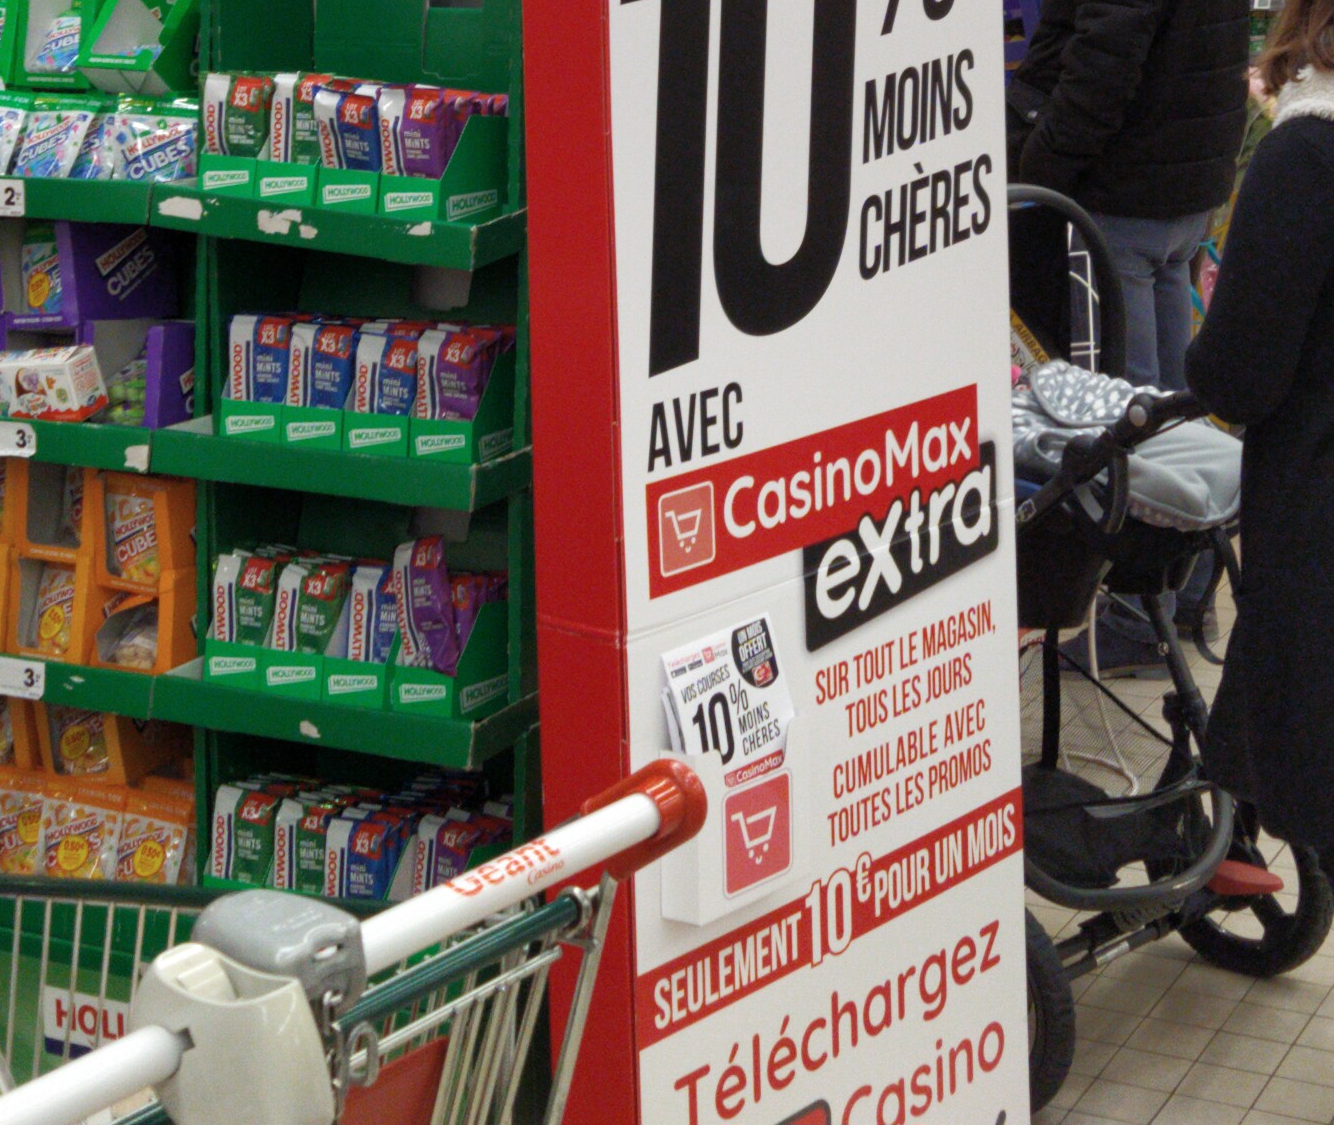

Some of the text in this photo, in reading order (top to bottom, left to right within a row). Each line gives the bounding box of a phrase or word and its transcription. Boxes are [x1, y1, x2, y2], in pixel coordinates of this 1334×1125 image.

[17, 134, 67, 166] CUBES
[862, 48, 975, 164] MOINS
[128, 140, 192, 179] CUBES
[859, 153, 993, 280] CHÈRES
[107, 245, 155, 296] CUBES
[647, 381, 744, 473] AVEC
[722, 412, 973, 540] CasinoMax
[680, 663, 730, 704] VOS COURSES
[739, 632, 767, 662] OFFERT
[815, 656, 852, 706] SUR
[854, 640, 898, 696] TOUT
[900, 630, 921, 681] LE
[923, 597, 997, 665] MAGASIN,
[738, 702, 770, 735] MOINS
[845, 653, 973, 739] TOUS LES JOURS
[736, 754, 783, 783] CasinoMax
[827, 739, 993, 848] TOUTES LES PROMOS
[832, 699, 987, 800] CUMULABLE AVEC
[528, 860, 564, 885] Casino
[652, 912, 802, 1030] SEULEMENT
[874, 850, 932, 916] POUR
[935, 840, 964, 893] UN
[967, 803, 1017, 871] MOIS
[673, 919, 1001, 1125] Téléchargez
[841, 1021, 1005, 1125] Casino
